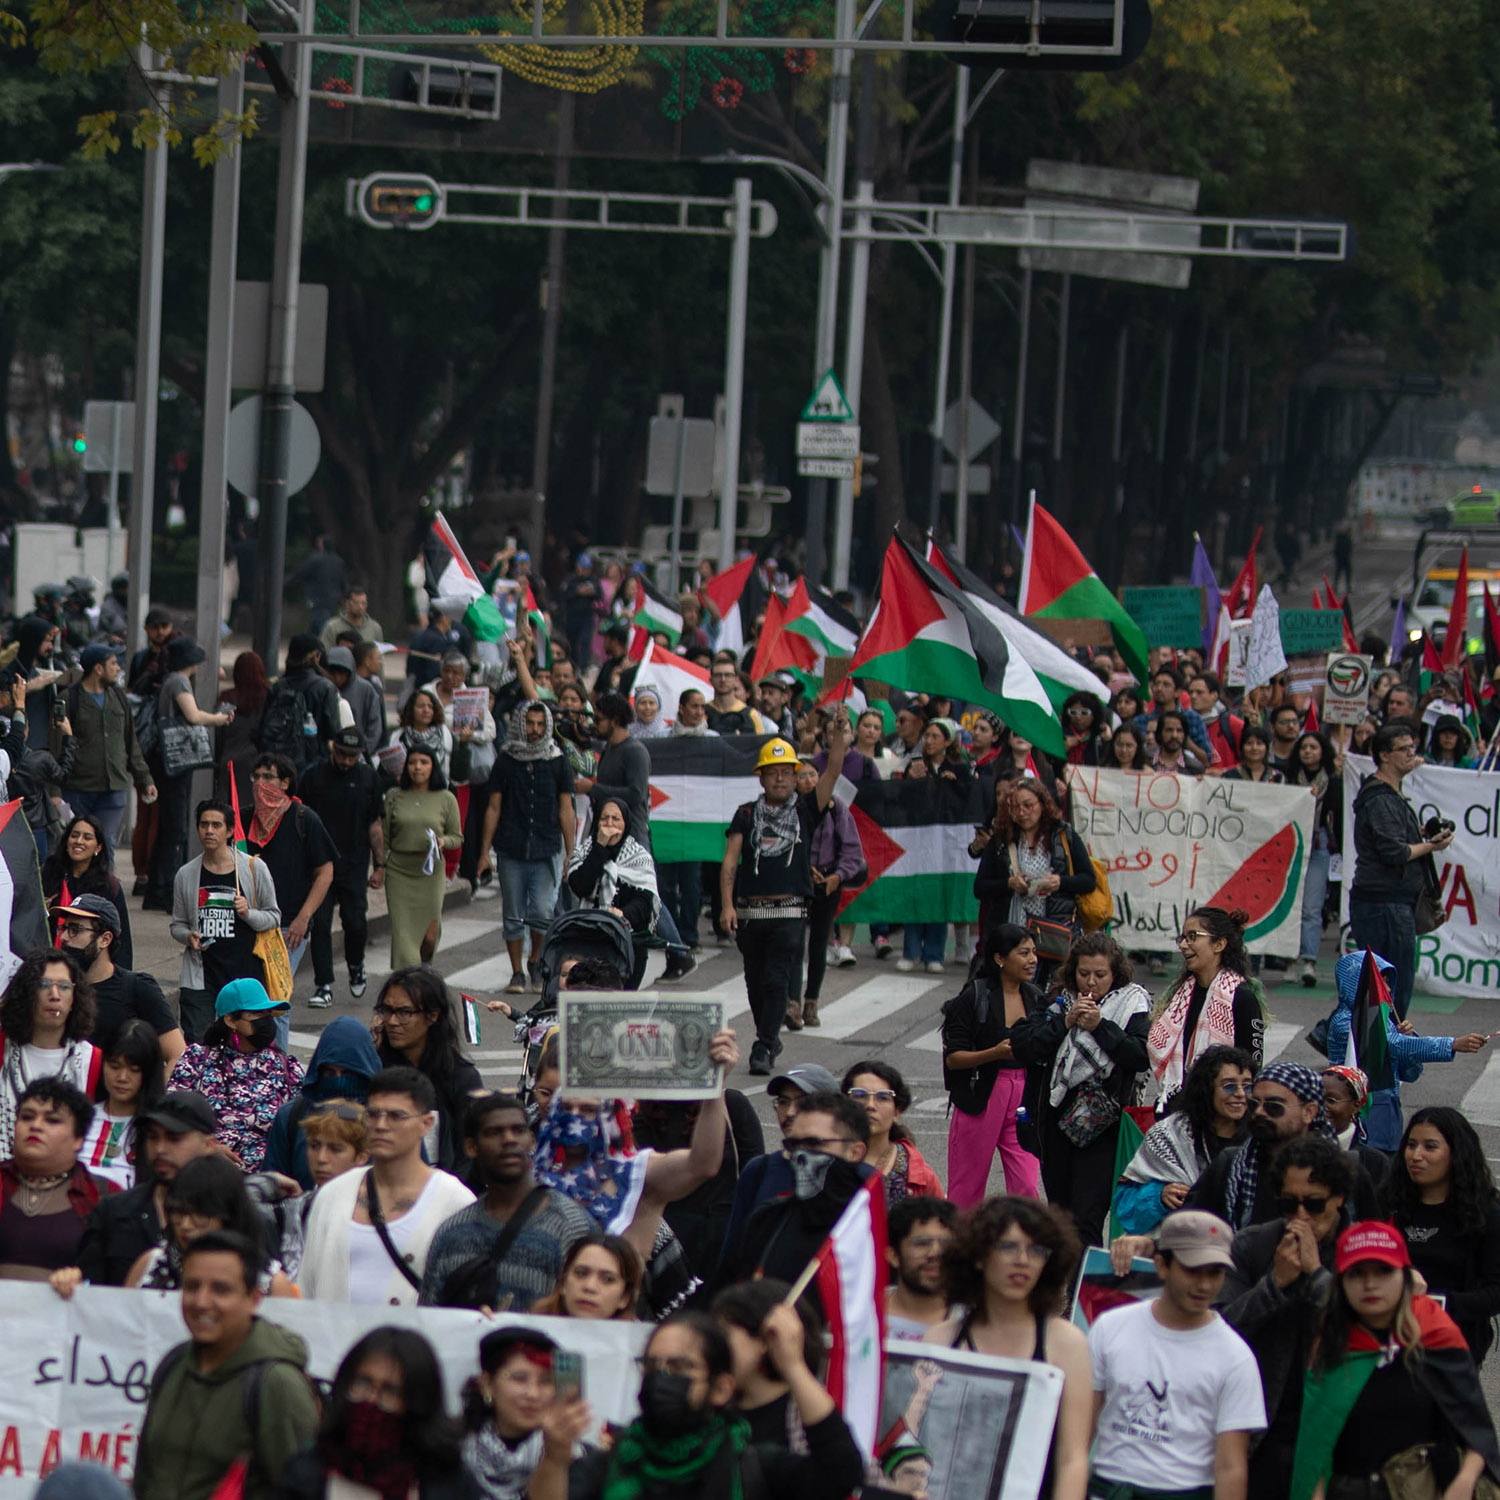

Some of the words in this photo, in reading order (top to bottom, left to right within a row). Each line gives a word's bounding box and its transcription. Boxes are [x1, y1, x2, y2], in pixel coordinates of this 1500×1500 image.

[1207, 784, 1245, 813] AL
[1071, 804, 1245, 842] GENOCIDIO
[618, 1033, 674, 1062] ONE
